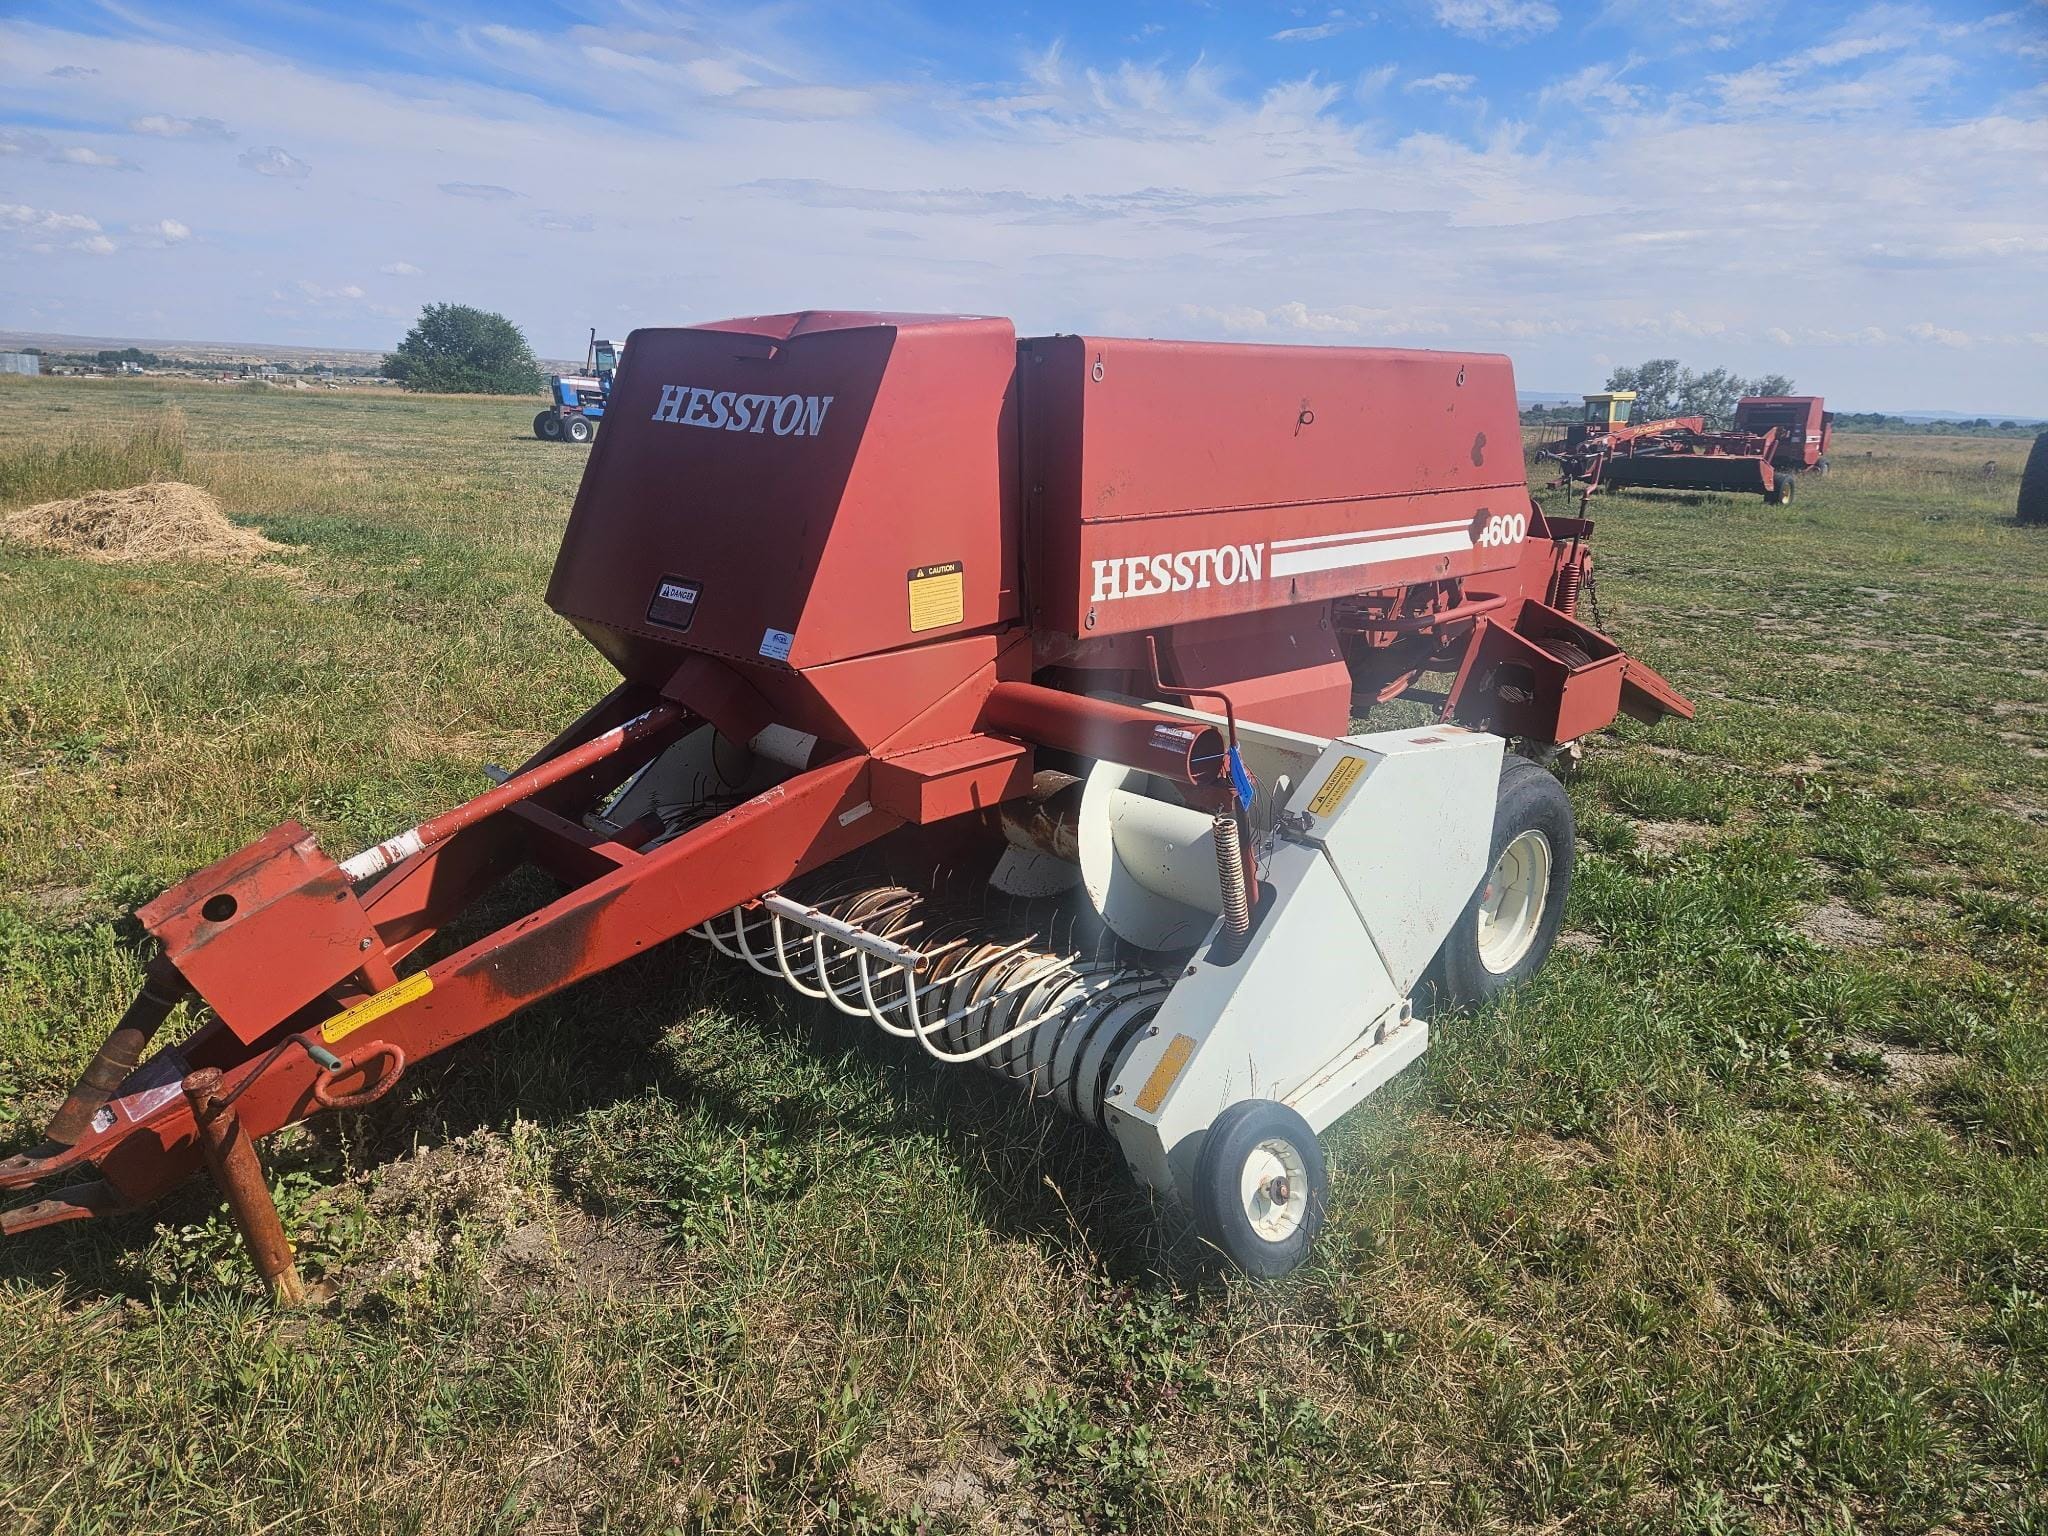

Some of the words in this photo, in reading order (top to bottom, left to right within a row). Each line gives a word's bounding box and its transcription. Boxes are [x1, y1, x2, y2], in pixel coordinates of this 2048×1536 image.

[651, 384, 834, 436] HESSTON
[928, 564, 955, 575] CAUTION
[1091, 543, 1265, 602] HESSTON
[669, 588, 694, 600] DANGER
[1324, 765, 1346, 791] WARNING
[362, 986, 401, 1008] WARNING
